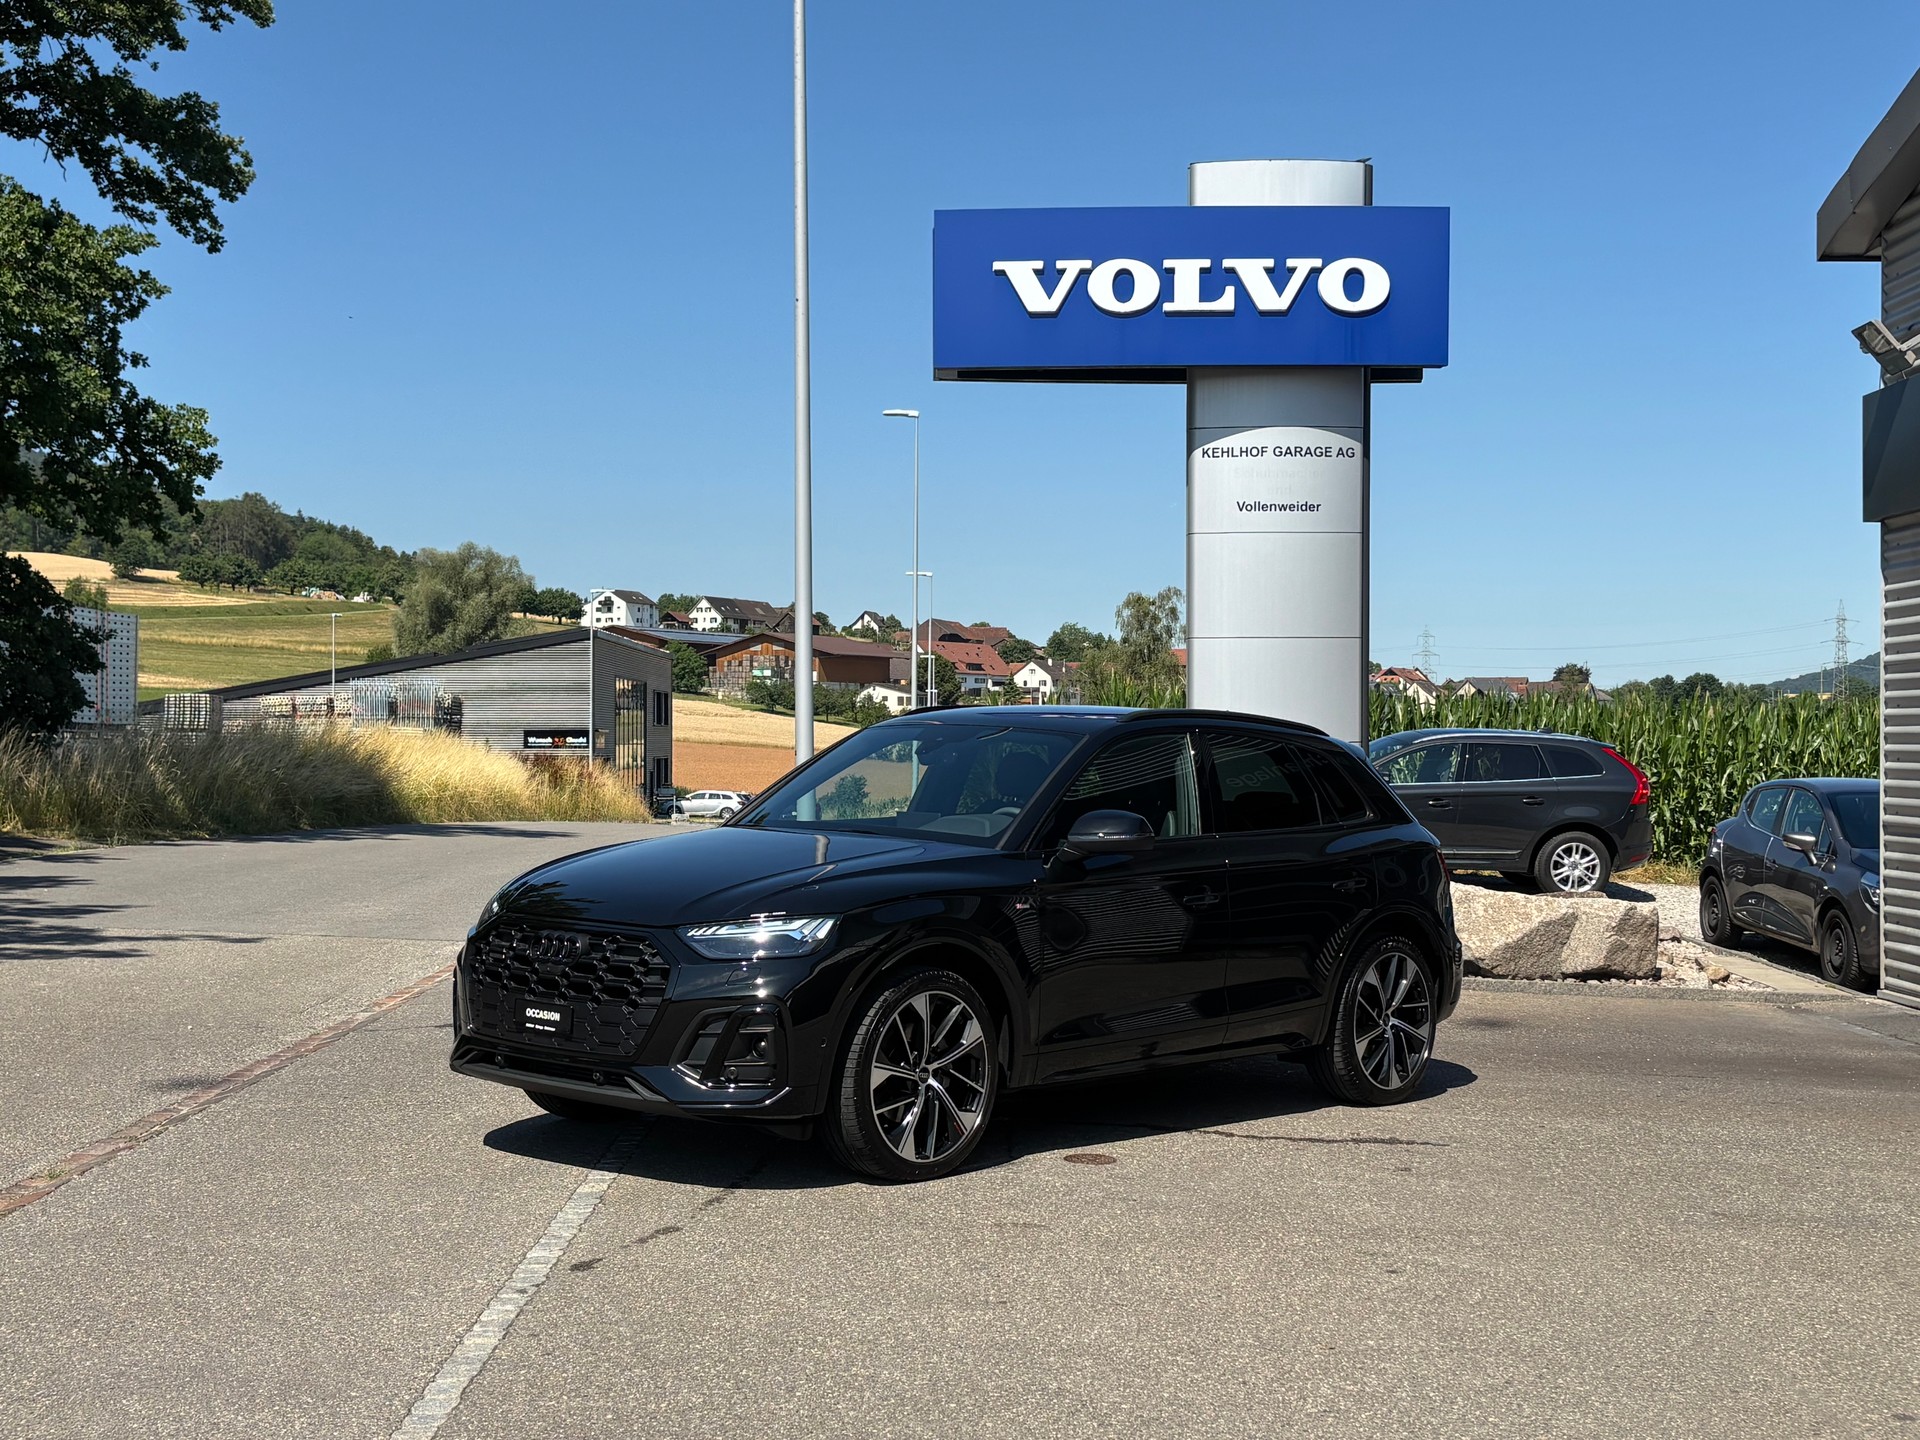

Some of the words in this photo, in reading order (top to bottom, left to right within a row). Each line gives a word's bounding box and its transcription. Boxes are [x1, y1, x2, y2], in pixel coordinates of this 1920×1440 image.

[992, 257, 1391, 317] VOLVO
[1201, 445, 1269, 459] KEHLHOF
[1272, 445, 1333, 458] GARAGE
[1335, 446, 1356, 459] AG
[1236, 500, 1322, 512] Vollenweider
[525, 1007, 561, 1021] OCCASION
